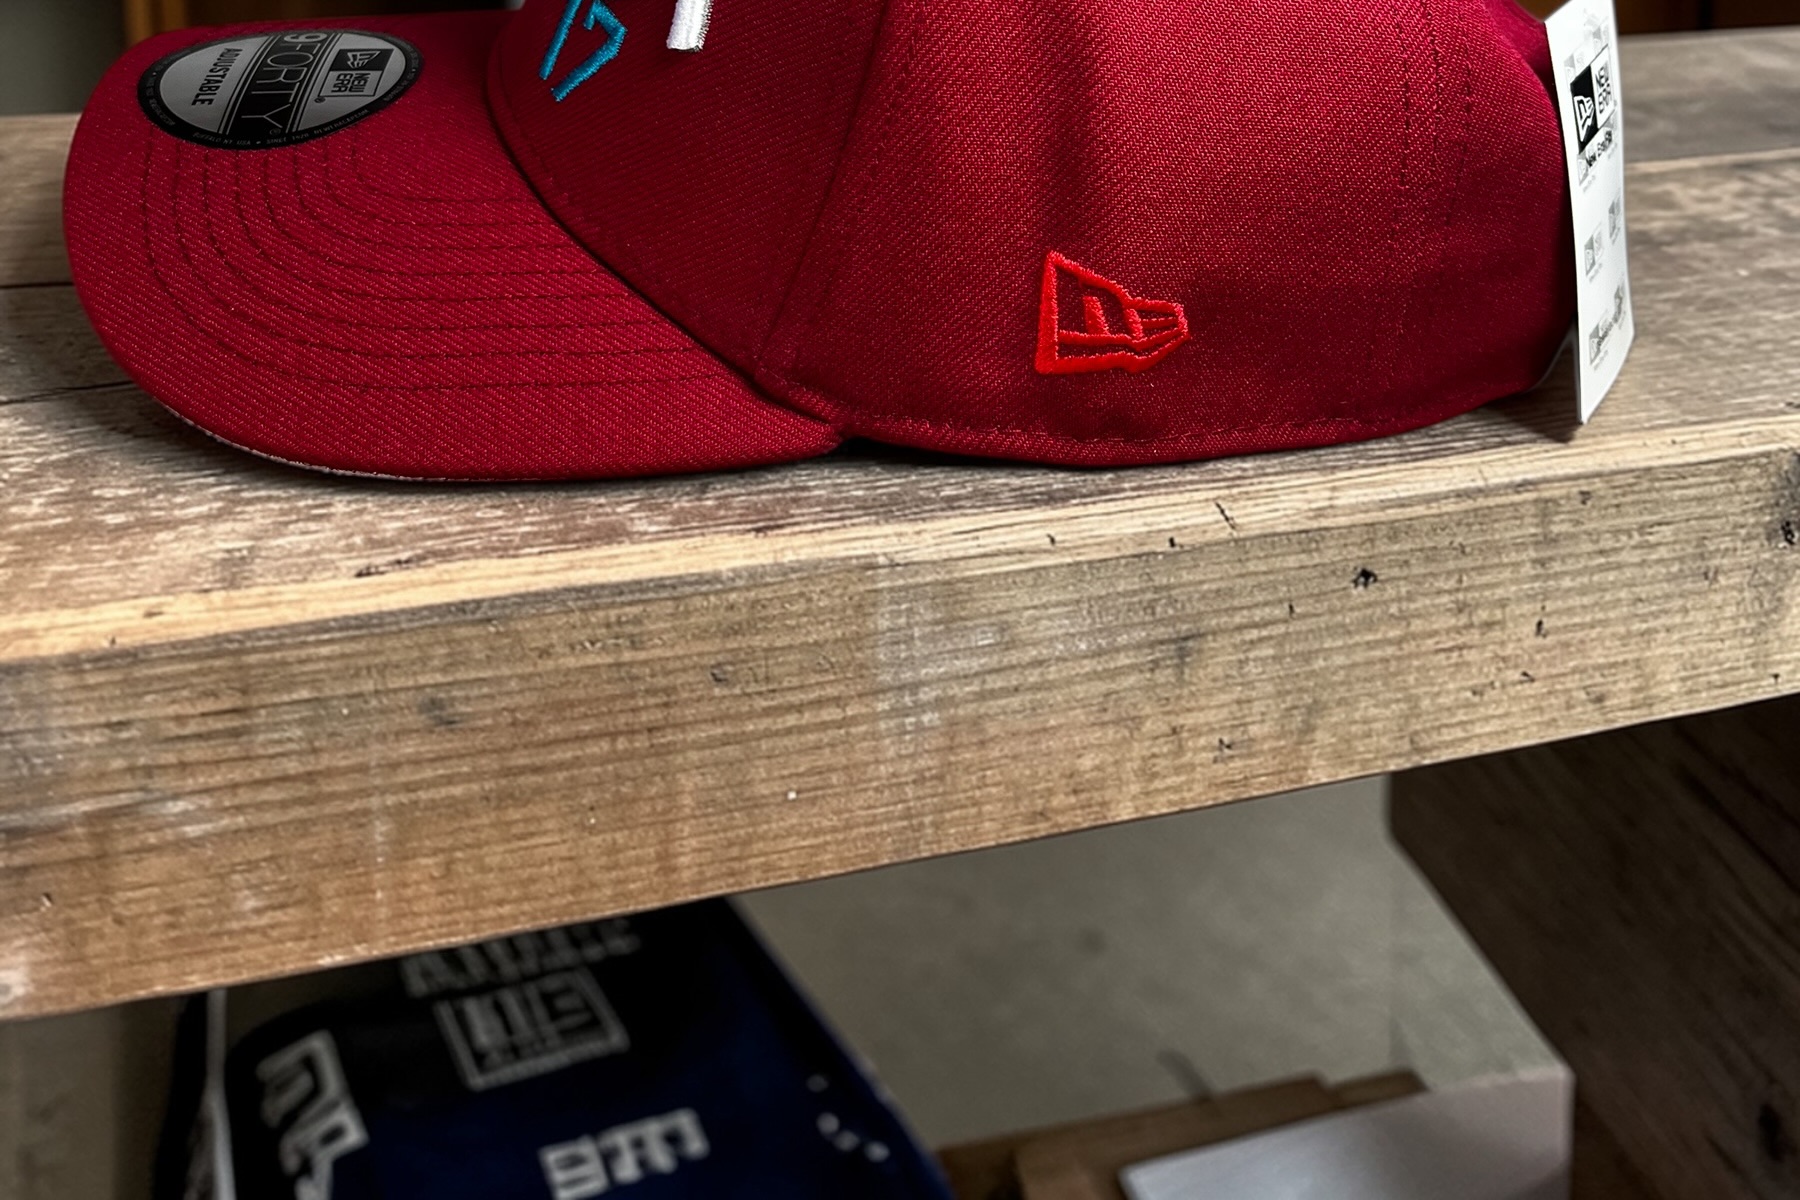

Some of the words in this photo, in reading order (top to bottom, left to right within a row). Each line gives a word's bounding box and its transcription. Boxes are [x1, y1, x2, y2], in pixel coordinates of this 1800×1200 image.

[191, 47, 243, 106] ADJUSTABLE
[241, 32, 328, 128] 9FORTY
[331, 73, 351, 93] ERA
[347, 72, 371, 93] NEW
